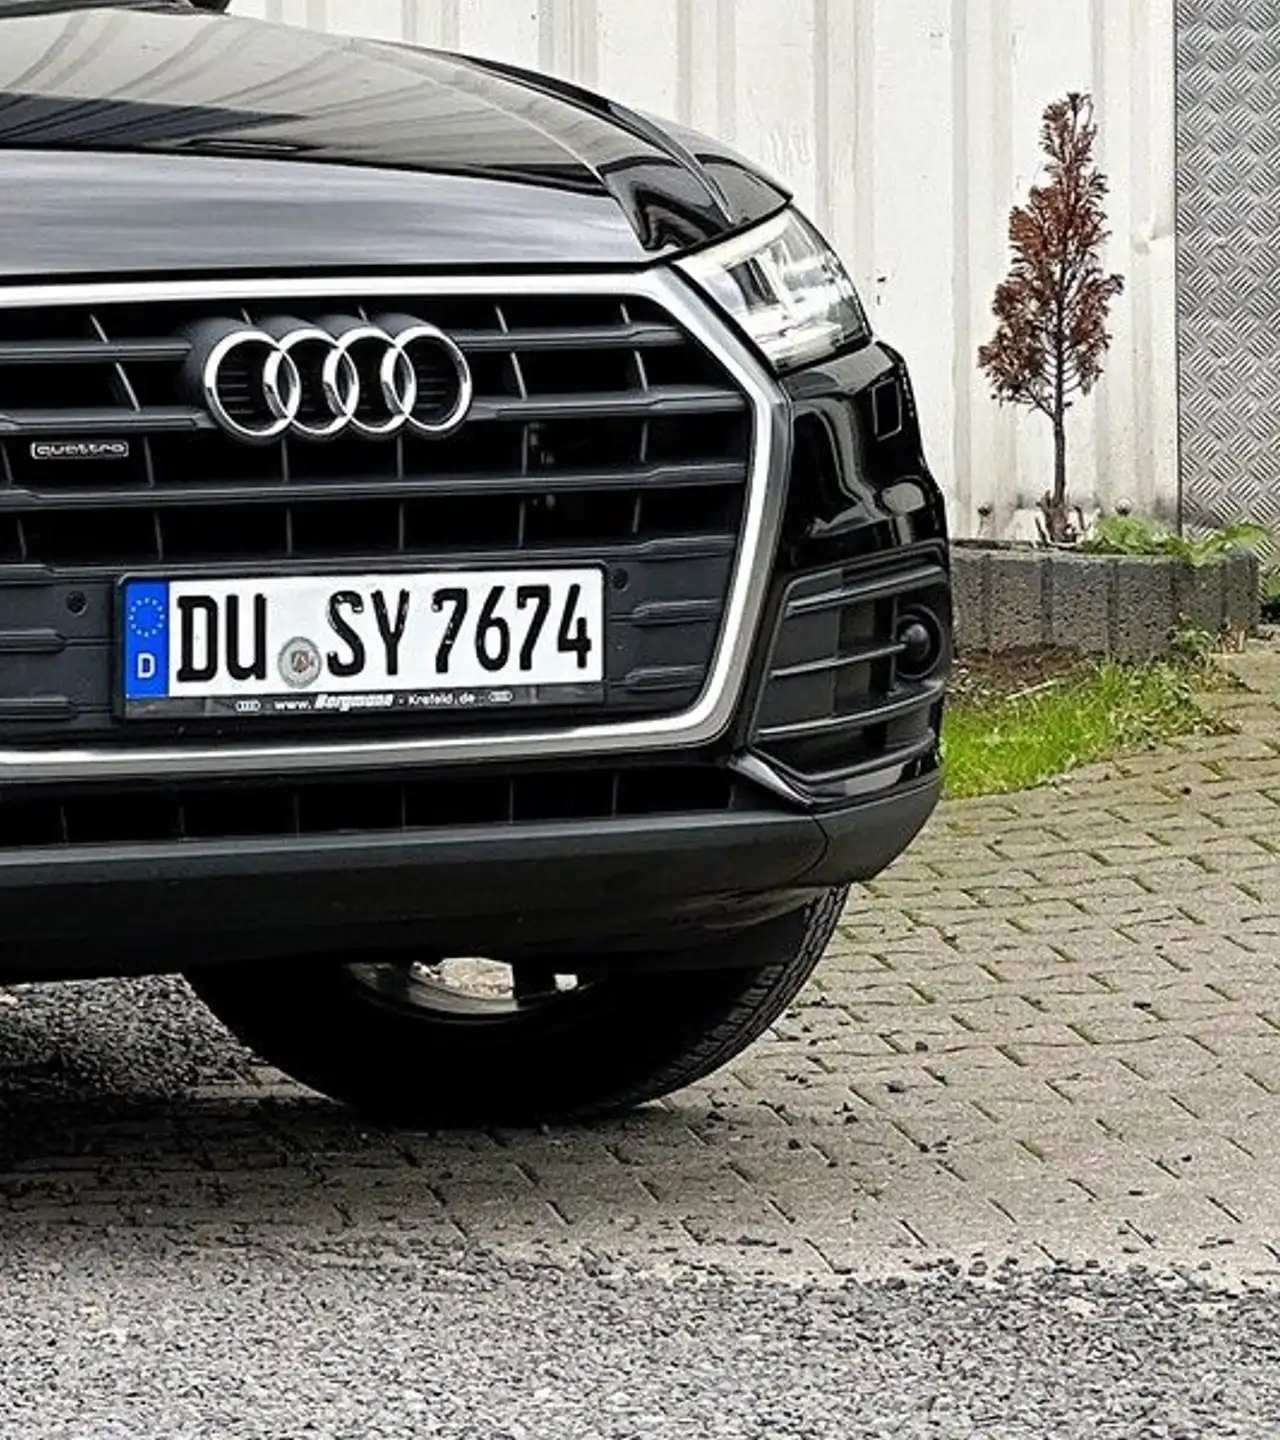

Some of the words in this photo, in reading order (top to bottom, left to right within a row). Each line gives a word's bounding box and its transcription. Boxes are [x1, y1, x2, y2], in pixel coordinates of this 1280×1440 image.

[35, 442, 125, 459] quattro
[176, 592, 267, 683] DU
[326, 588, 410, 678] SY
[431, 582, 593, 675] 7674
[137, 652, 156, 679] D
